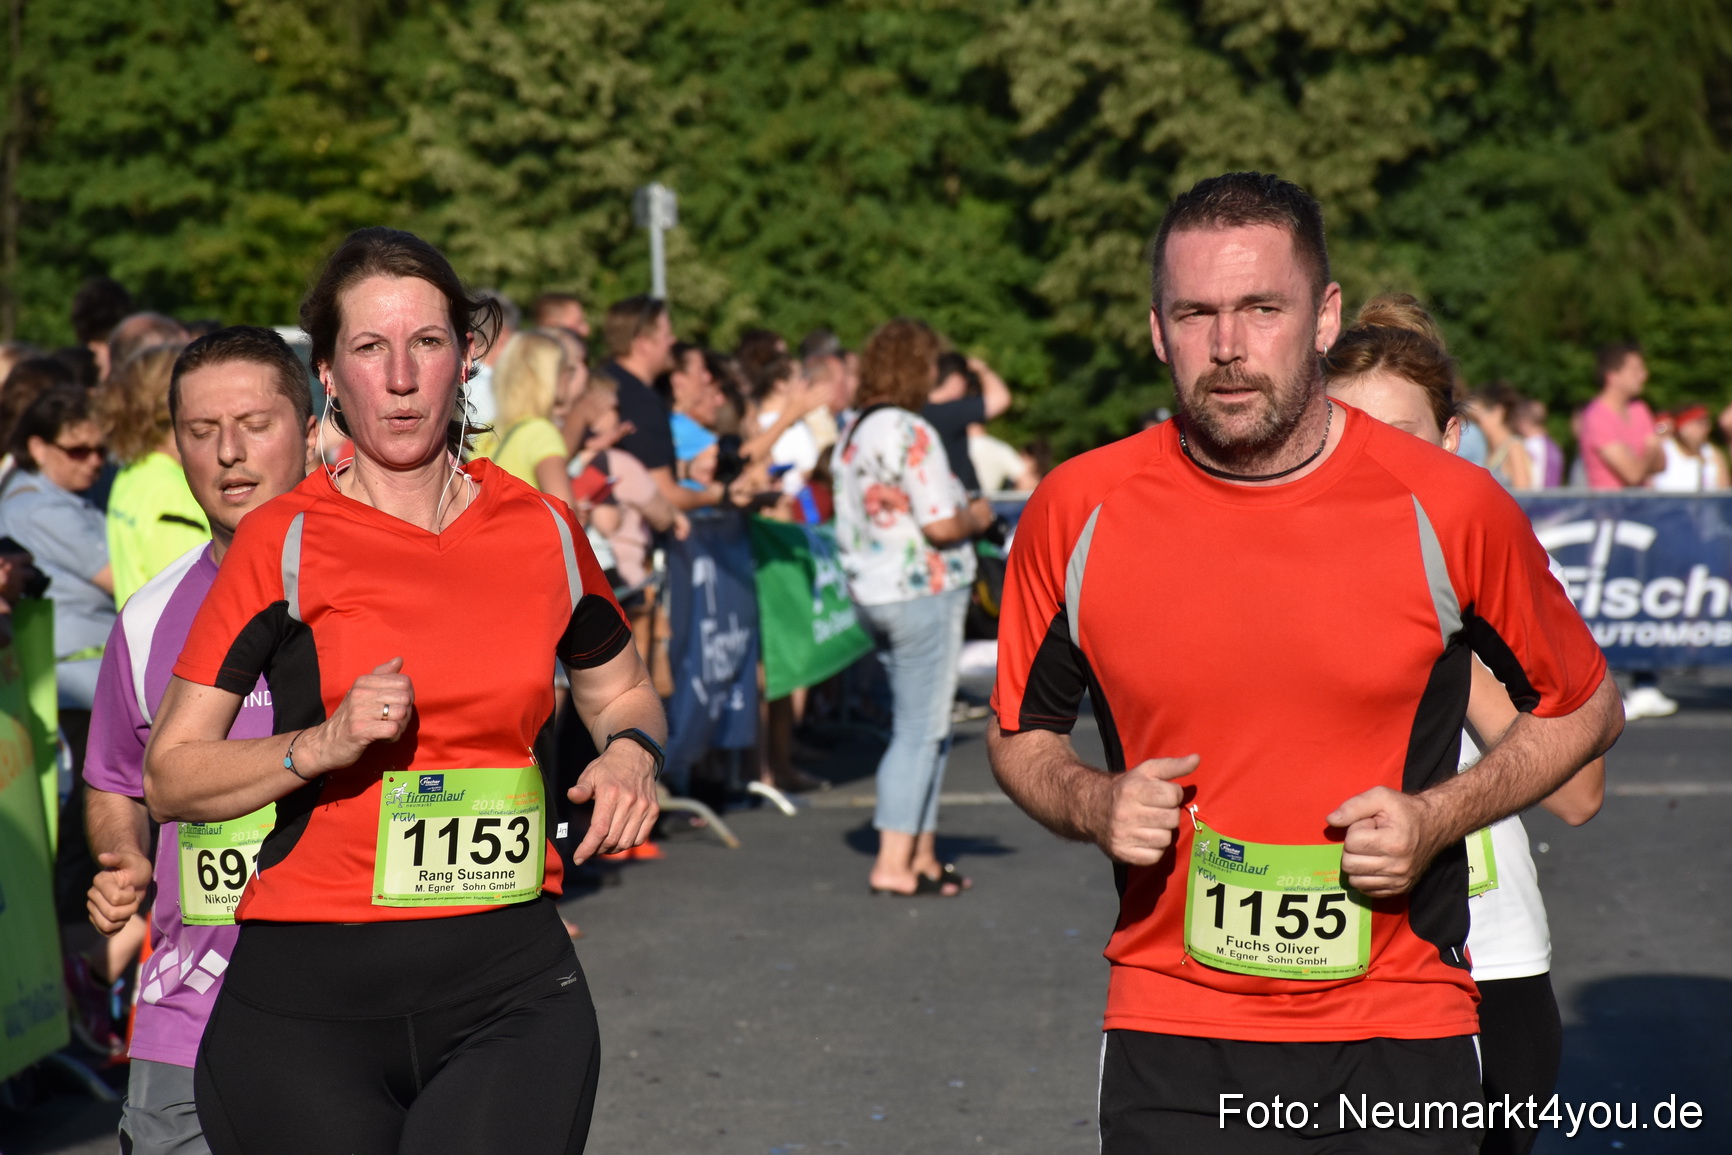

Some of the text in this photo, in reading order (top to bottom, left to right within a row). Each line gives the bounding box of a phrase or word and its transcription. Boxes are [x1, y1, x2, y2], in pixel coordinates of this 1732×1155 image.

[1564, 564, 1732, 619] Fisch
[1586, 621, 1732, 648] UTOMOB
[406, 789, 466, 803] firmenlauf
[472, 800, 504, 810] 2018
[231, 830, 260, 842] 2018
[404, 816, 530, 867] 1153
[197, 848, 258, 892] 69
[1209, 851, 1270, 876] firmenlauf
[419, 868, 515, 883] Rang Susanne
[1276, 875, 1312, 887] 2018
[415, 881, 516, 893] M. Egner Sohn GmbH
[1206, 882, 1347, 940] 1155
[1226, 935, 1320, 955] Fuchs Oliver
[1216, 946, 1227, 956] M.
[1230, 949, 1259, 961] Egner
[1267, 954, 1293, 965] Sohn
[1296, 956, 1328, 966] GmbH
